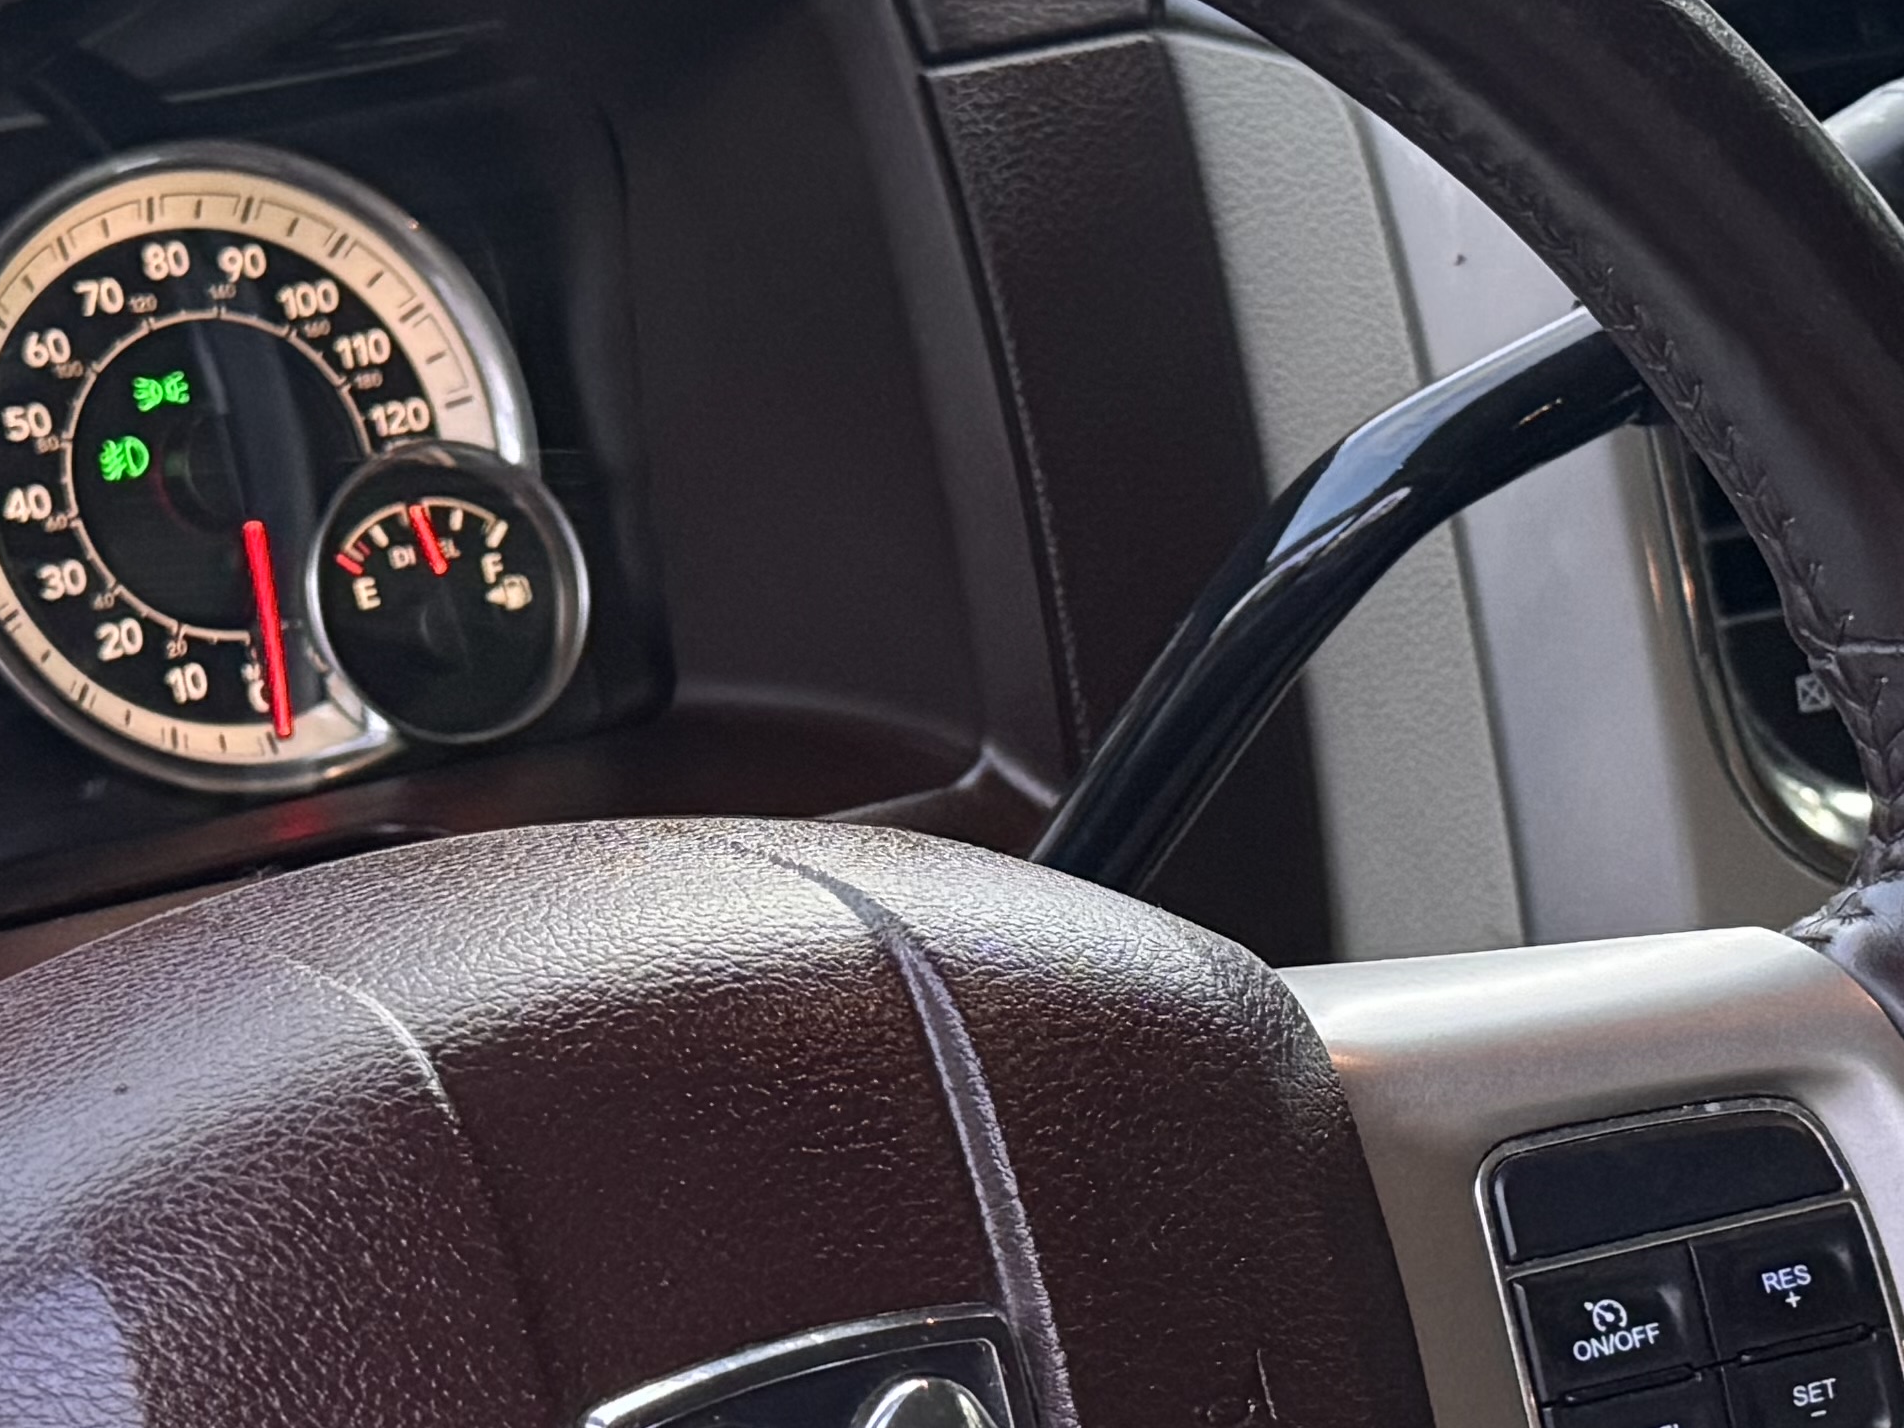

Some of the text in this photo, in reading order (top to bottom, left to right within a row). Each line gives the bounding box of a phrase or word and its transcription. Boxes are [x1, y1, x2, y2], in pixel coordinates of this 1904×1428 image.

[141, 240, 190, 281] 80
[217, 243, 267, 283] 90
[73, 276, 125, 317] 70
[128, 292, 158, 315] 120
[276, 278, 340, 321] 100
[21, 328, 71, 369] 60
[333, 328, 392, 371] 110
[0, 401, 52, 443] 50
[368, 396, 432, 439] 120
[2, 483, 52, 524] 40
[36, 559, 87, 602] 30
[481, 551, 504, 584] F
[351, 576, 381, 612] E
[95, 617, 144, 662] 20
[165, 639, 189, 659] 20
[163, 662, 209, 705] 10
[1761, 1264, 1812, 1294] RES
[1573, 1323, 1660, 1362] ON/OFF
[1792, 1378, 1837, 1407] SET
